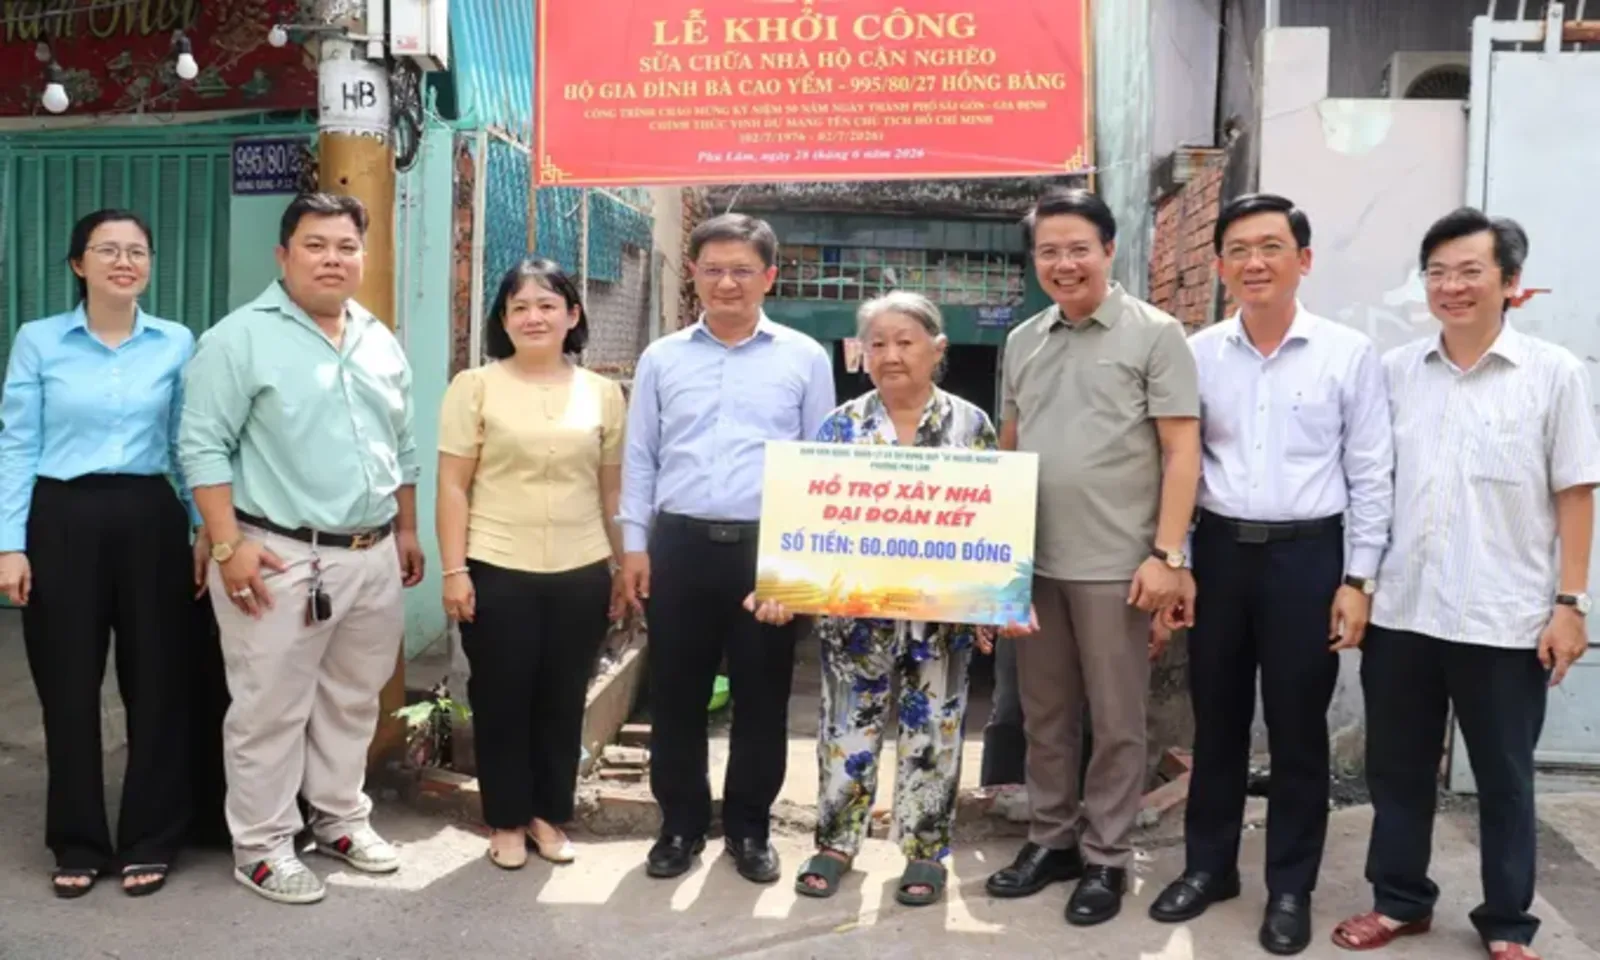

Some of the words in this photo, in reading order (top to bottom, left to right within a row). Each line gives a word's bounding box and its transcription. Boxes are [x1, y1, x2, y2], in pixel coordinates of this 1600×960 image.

[653, 9, 709, 46] LỄ
[723, 8, 838, 43] KHỞI
[853, 7, 976, 41] CÔNG
[639, 51, 682, 72] SỬA
[688, 50, 753, 72] CHỮA
[760, 48, 810, 70] NHÀ
[818, 47, 851, 71] HỘ
[858, 47, 906, 71] CẬN
[914, 47, 996, 67] NGHÈO
[342, 80, 376, 110] HB
[564, 80, 594, 102] HỘ
[599, 83, 637, 99] GIA
[643, 80, 697, 99] ĐÌNH
[705, 77, 734, 97] BÀ
[738, 79, 781, 96] CAO
[787, 71, 832, 94] YẾM
[851, 75, 936, 93] 995/80/27
[942, 70, 1001, 92] HỒNG
[1008, 70, 1065, 91] BÀNG
[808, 474, 841, 496] HỖ
[847, 479, 891, 504] TRỢ
[894, 480, 940, 503] XÂY
[945, 483, 992, 505] NHÀ
[823, 505, 860, 525] ĐẠI
[865, 505, 932, 526] ĐOÀN
[935, 507, 976, 528] KẾT
[781, 527, 806, 552] SỐ
[811, 529, 854, 555] TIỀN:
[860, 536, 956, 560] 60.000.000
[962, 538, 1011, 563] ĐỒNG
